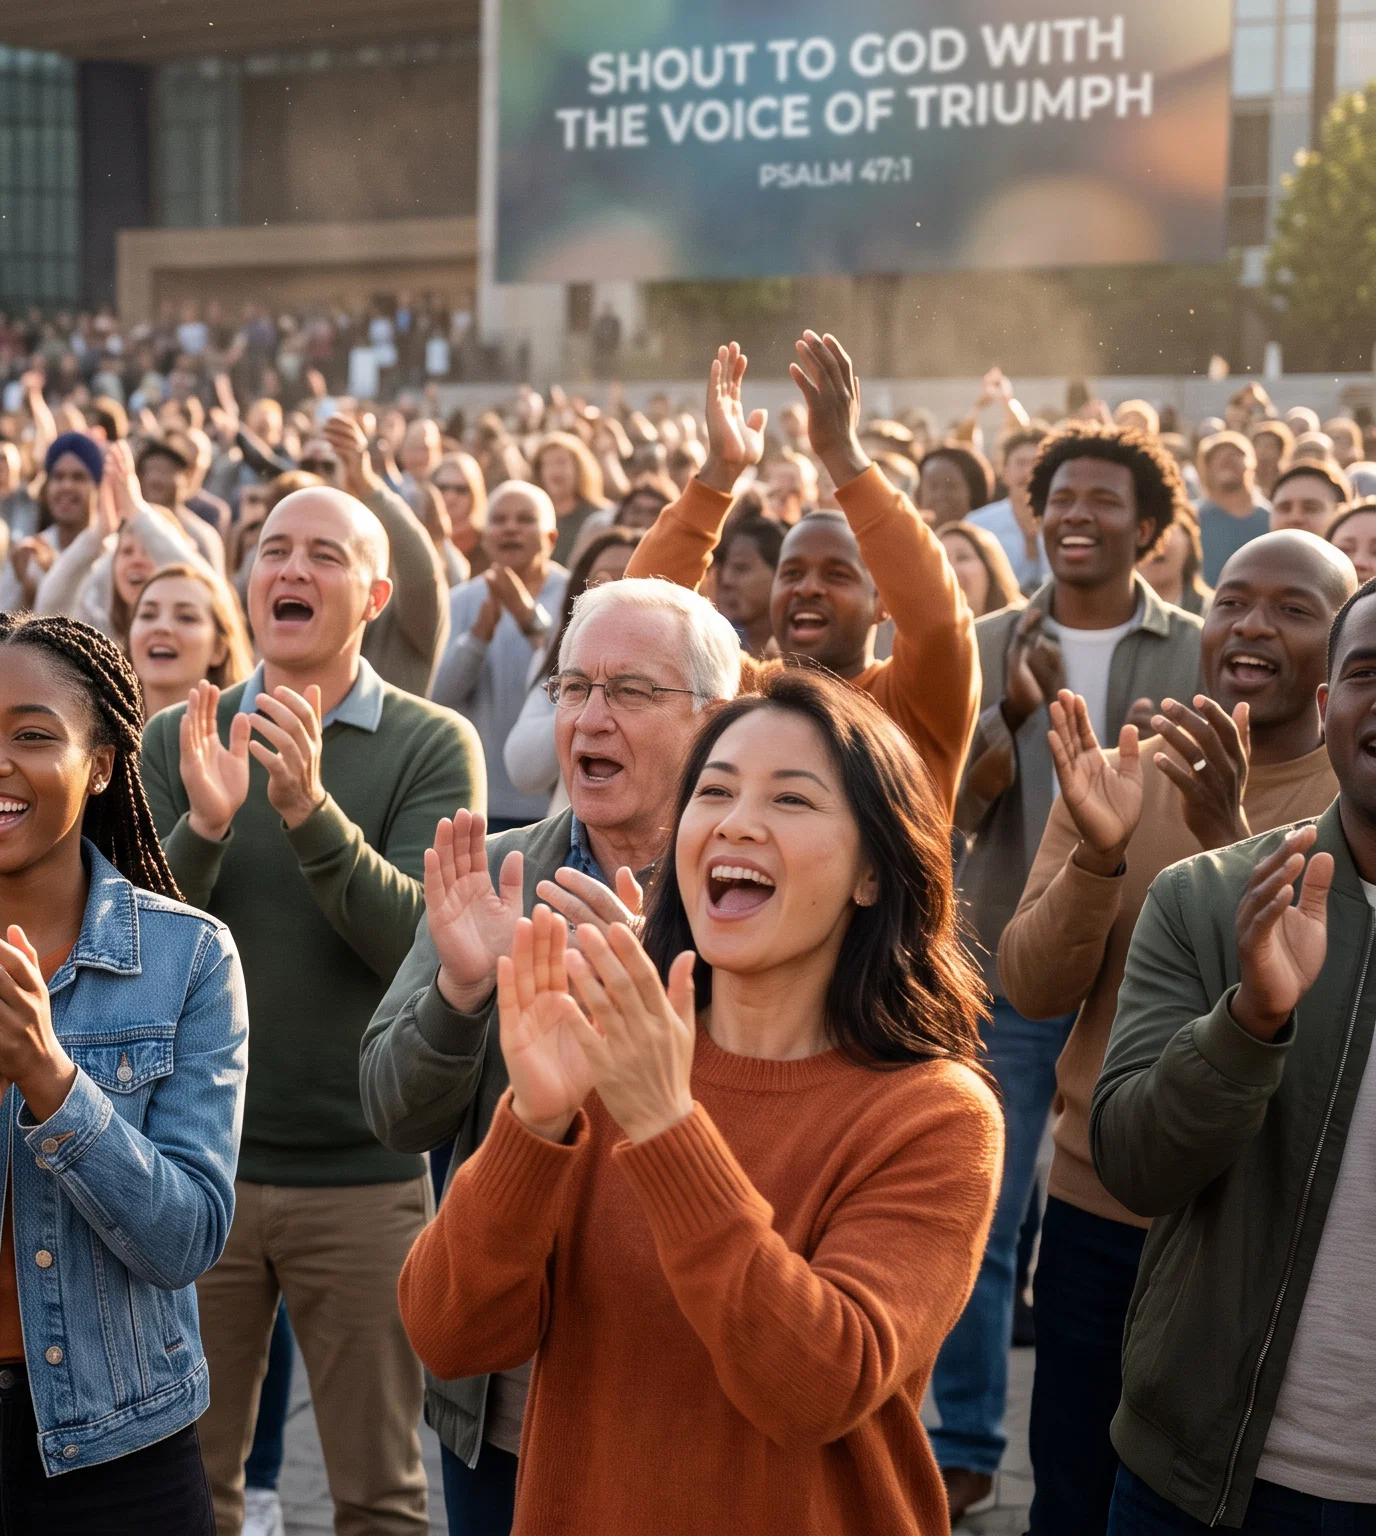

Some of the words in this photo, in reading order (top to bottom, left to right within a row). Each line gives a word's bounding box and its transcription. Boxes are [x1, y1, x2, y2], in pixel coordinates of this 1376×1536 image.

[588, 42, 755, 95] SHOUT
[767, 37, 836, 82] TO
[849, 28, 966, 76] GOD
[981, 16, 1124, 67] WITH
[556, 104, 648, 149] THE
[660, 94, 810, 143] VOICE
[825, 89, 894, 135] OF
[906, 73, 1152, 130] TRIUMPH
[759, 160, 853, 188] PSALM
[859, 156, 912, 183] 47:1
